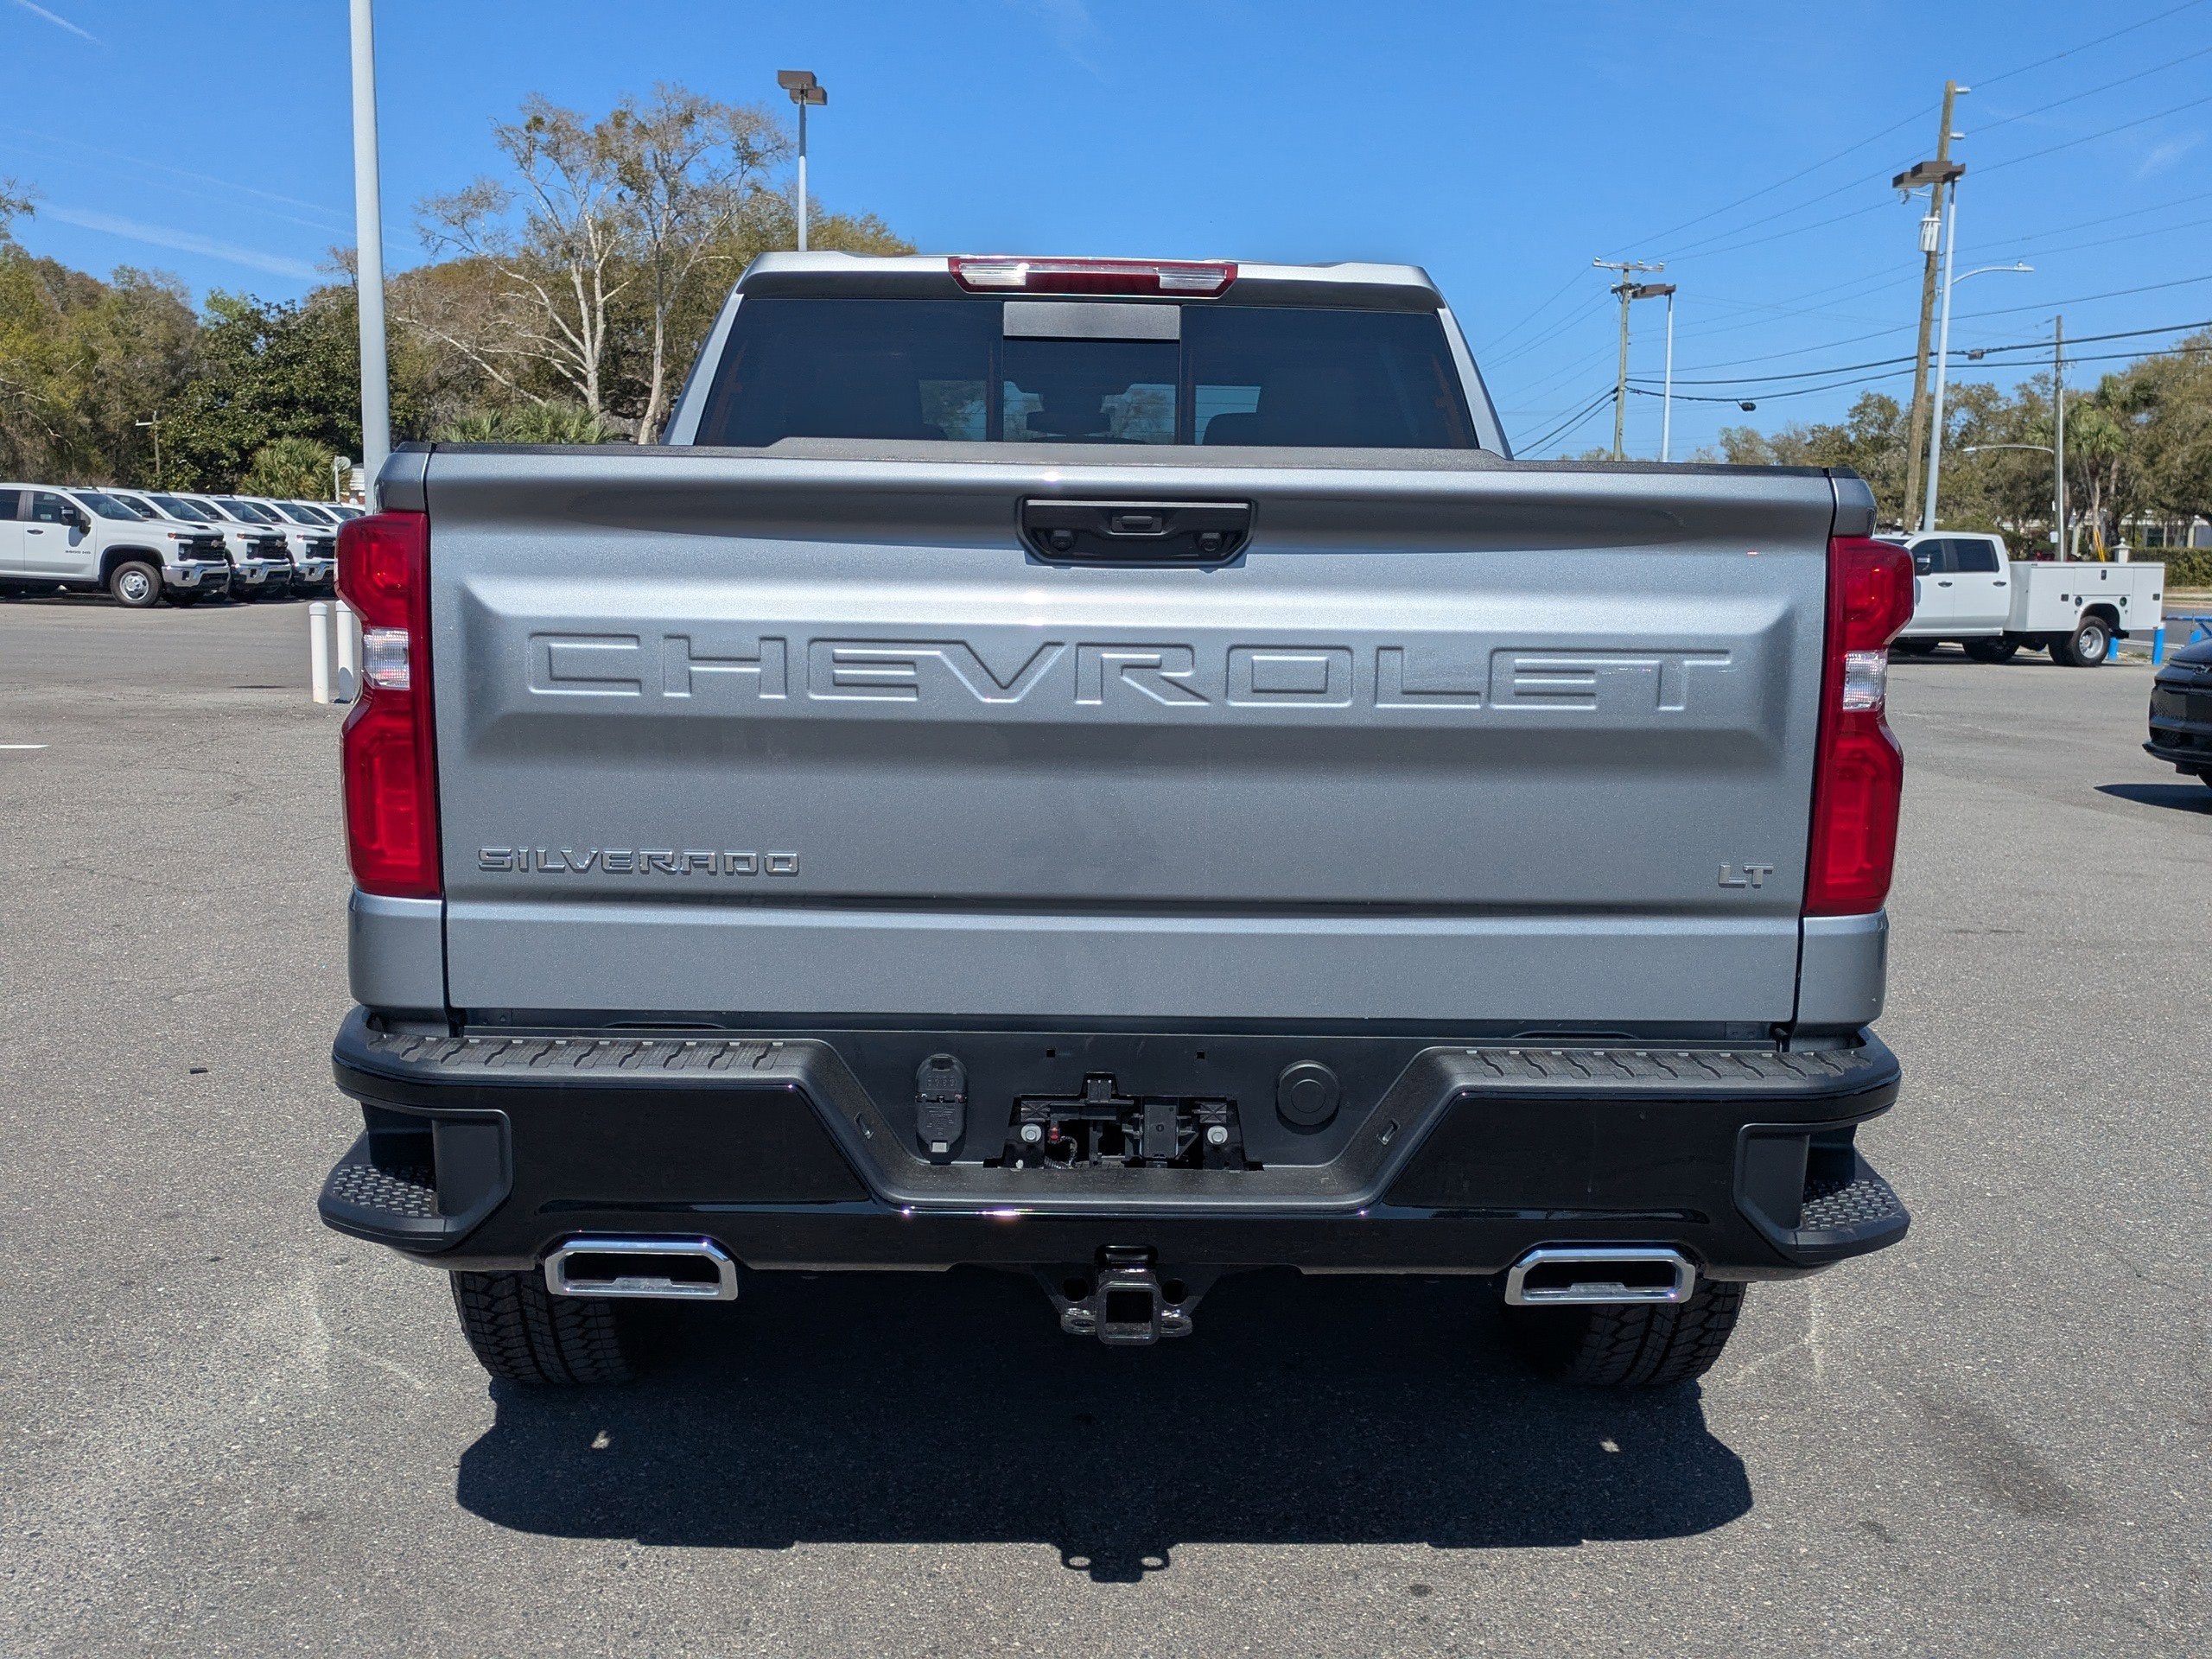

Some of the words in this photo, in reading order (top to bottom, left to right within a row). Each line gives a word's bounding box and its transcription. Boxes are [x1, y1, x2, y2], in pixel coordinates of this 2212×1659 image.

[528, 632, 1732, 710] CHEVROLET
[478, 847, 800, 875] SILVERADO
[1719, 862, 1774, 888] LT
